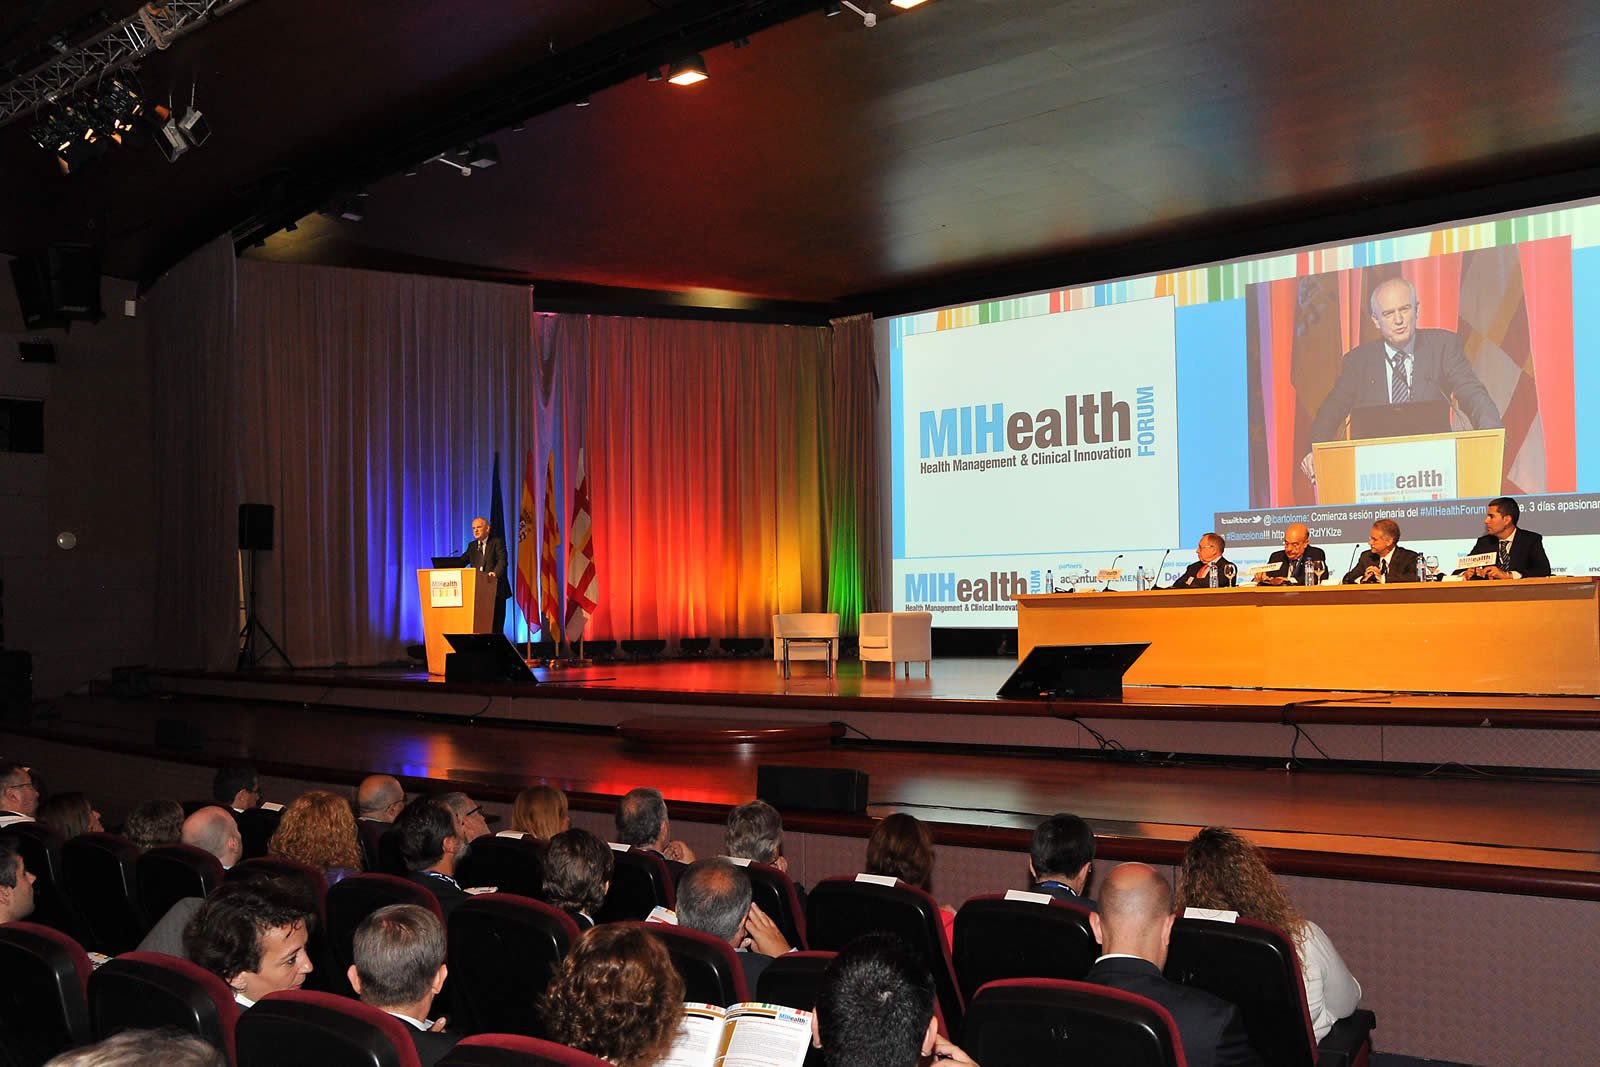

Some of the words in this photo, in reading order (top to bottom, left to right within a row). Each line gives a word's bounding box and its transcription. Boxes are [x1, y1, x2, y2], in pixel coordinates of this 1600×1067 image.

[920, 391, 1131, 458] MIHealth
[1137, 386, 1155, 457] FORUM
[920, 459, 951, 474] Health
[953, 456, 1017, 472] Management
[1020, 453, 1029, 466] &
[1031, 450, 1071, 465] Clinical
[1074, 447, 1131, 462] Innovation
[1360, 470, 1443, 491] MIHealth
[1221, 515, 1252, 525] twitter
[1311, 511, 1347, 521] Comienza
[1349, 509, 1372, 520] sesión
[1375, 507, 1405, 520] plenaria
[1407, 506, 1419, 517] del
[1420, 504, 1487, 516] #MIHealthForum
[1529, 501, 1535, 512] 3
[1537, 500, 1556, 512] días
[905, 571, 1027, 603] MIHealth
[1030, 570, 1041, 594] RUM
[905, 604, 923, 612] Health
[925, 603, 962, 613] Management
[971, 603, 994, 612] Clinical
[995, 603, 1018, 611] Innovat
